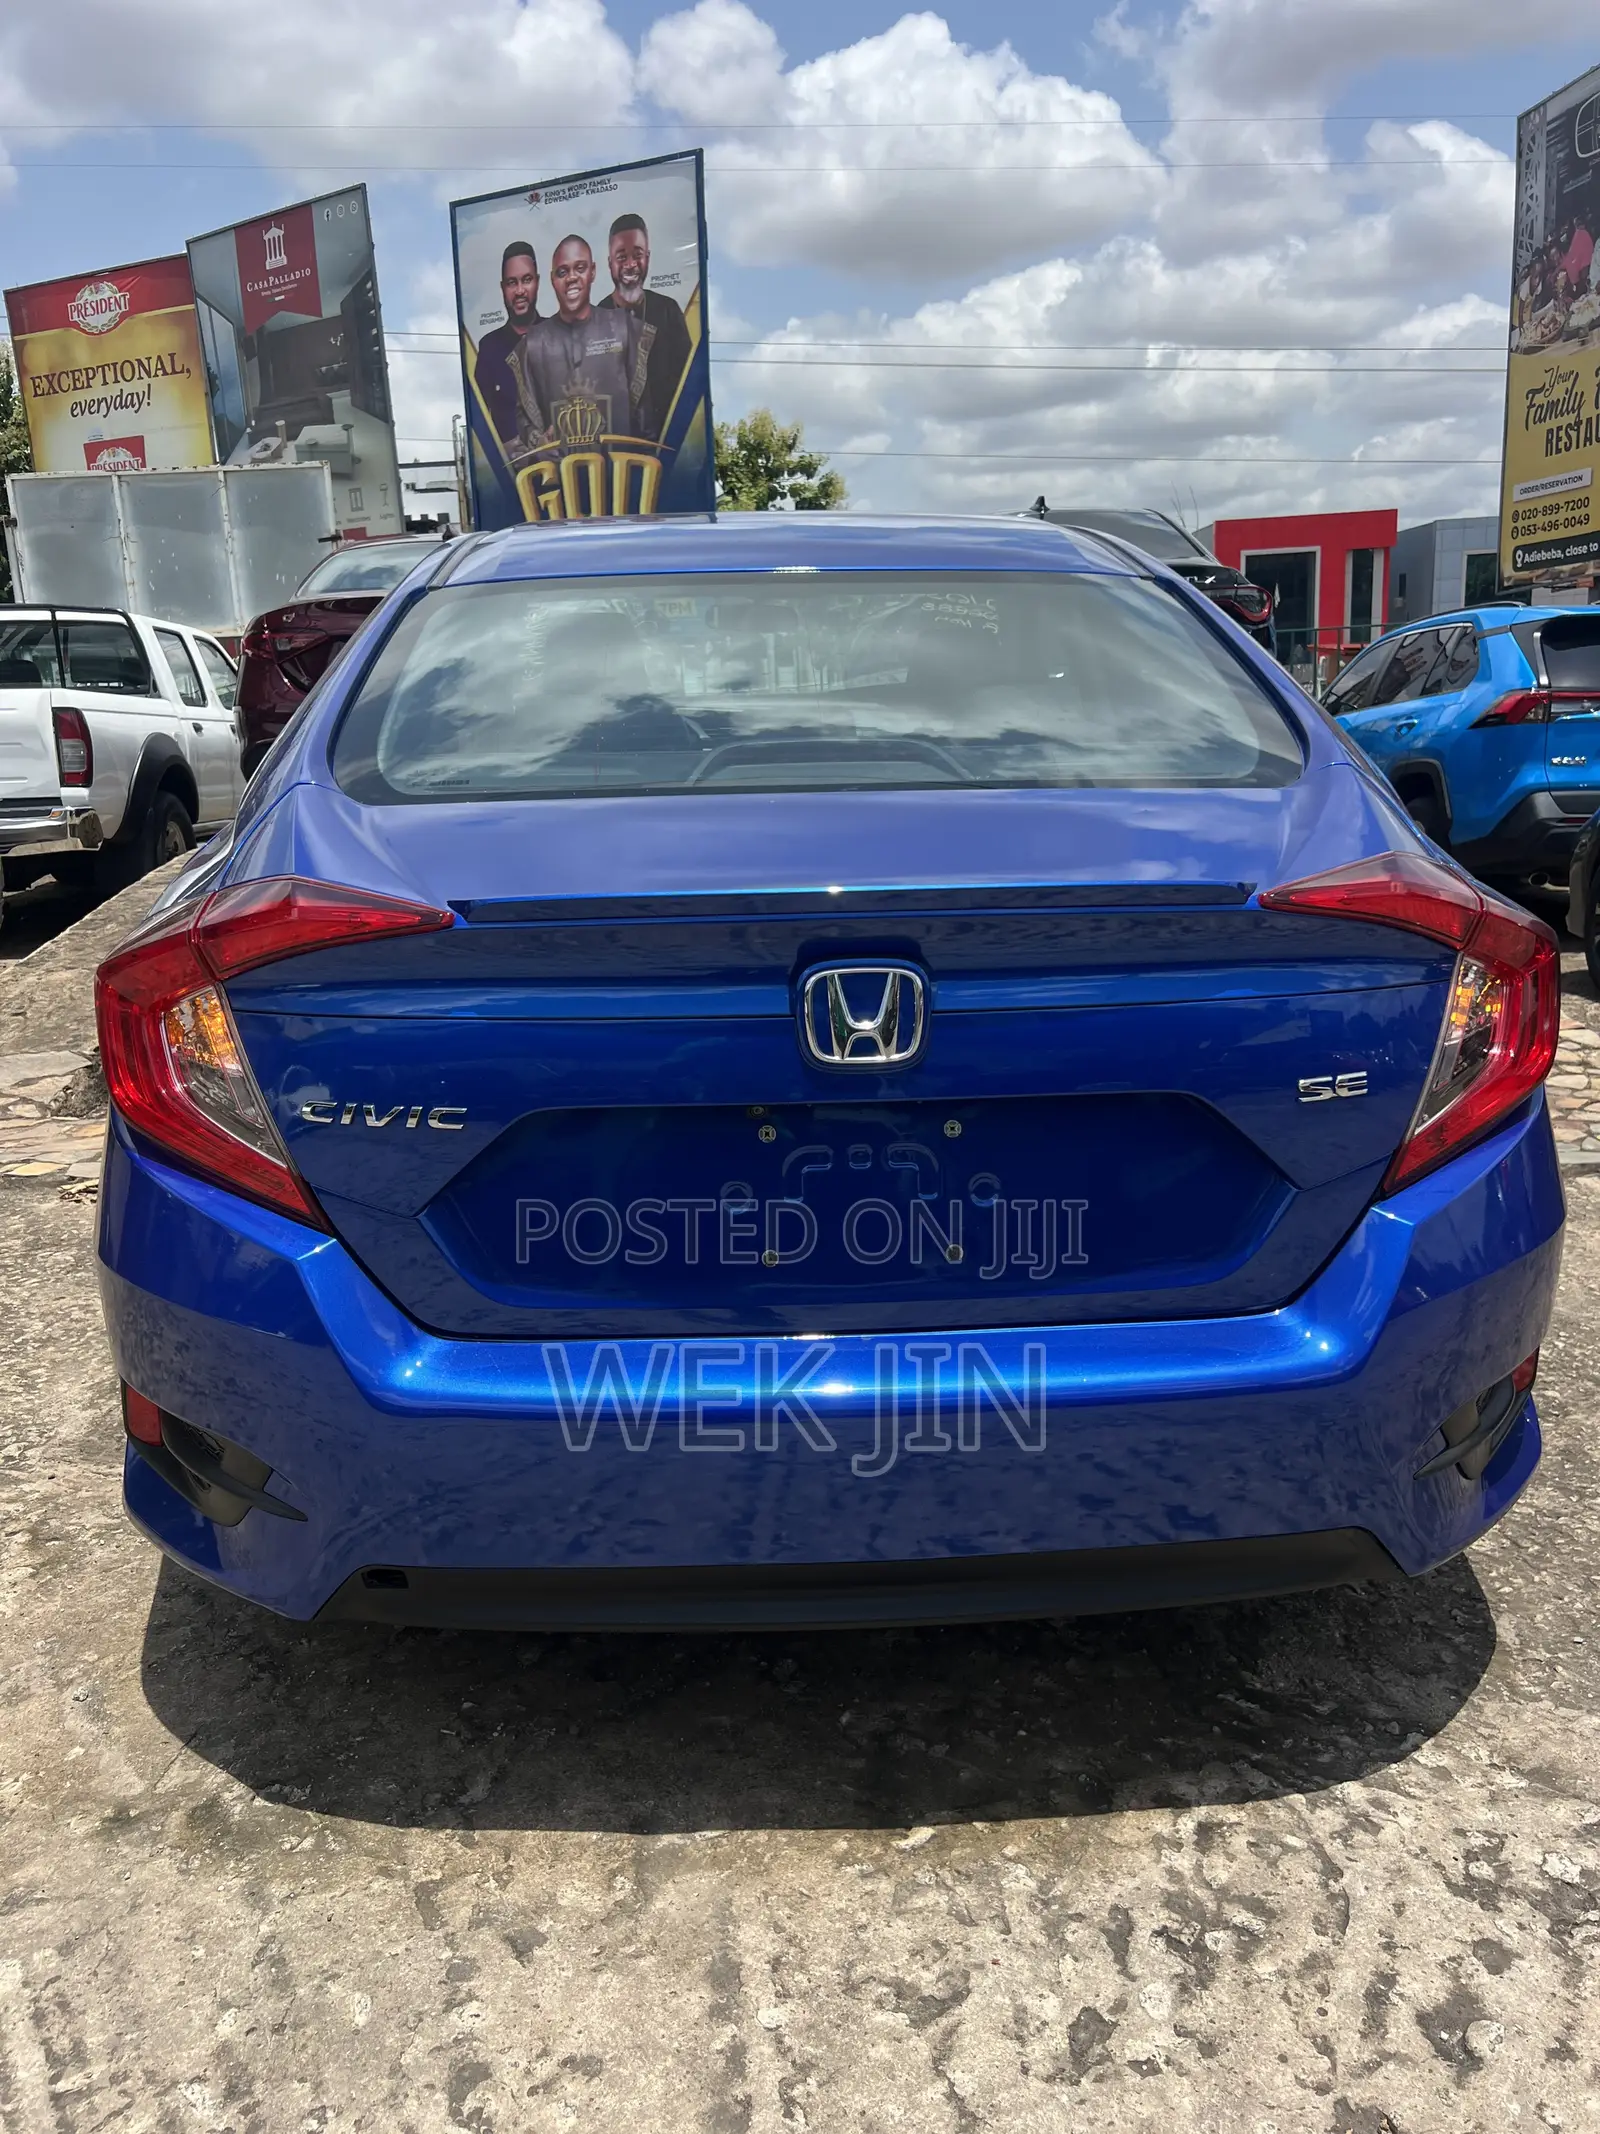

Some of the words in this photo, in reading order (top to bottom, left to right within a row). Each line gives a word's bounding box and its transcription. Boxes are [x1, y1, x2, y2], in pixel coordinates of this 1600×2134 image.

[544, 188, 566, 198] KING'S
[567, 182, 588, 192] WORD
[588, 178, 611, 189] FAMILY
[585, 183, 618, 196] KWADASO
[69, 293, 129, 321] PRÉSIDENT
[29, 352, 192, 398] EXCEPTIONAL,
[1544, 365, 1574, 398] Your
[70, 383, 151, 418] everyday!
[1525, 371, 1586, 432] Family
[1519, 474, 1584, 495] ORDER/RESERVATION
[1521, 496, 1590, 521] 020-899-7200
[1520, 513, 1590, 537] 053-496-0049
[1523, 548, 1565, 564] Adiebeba,
[1565, 545, 1588, 557] close
[1589, 542, 1599, 552] to
[1297, 1071, 1368, 1103] SE
[300, 1100, 468, 1130] CIVIC
